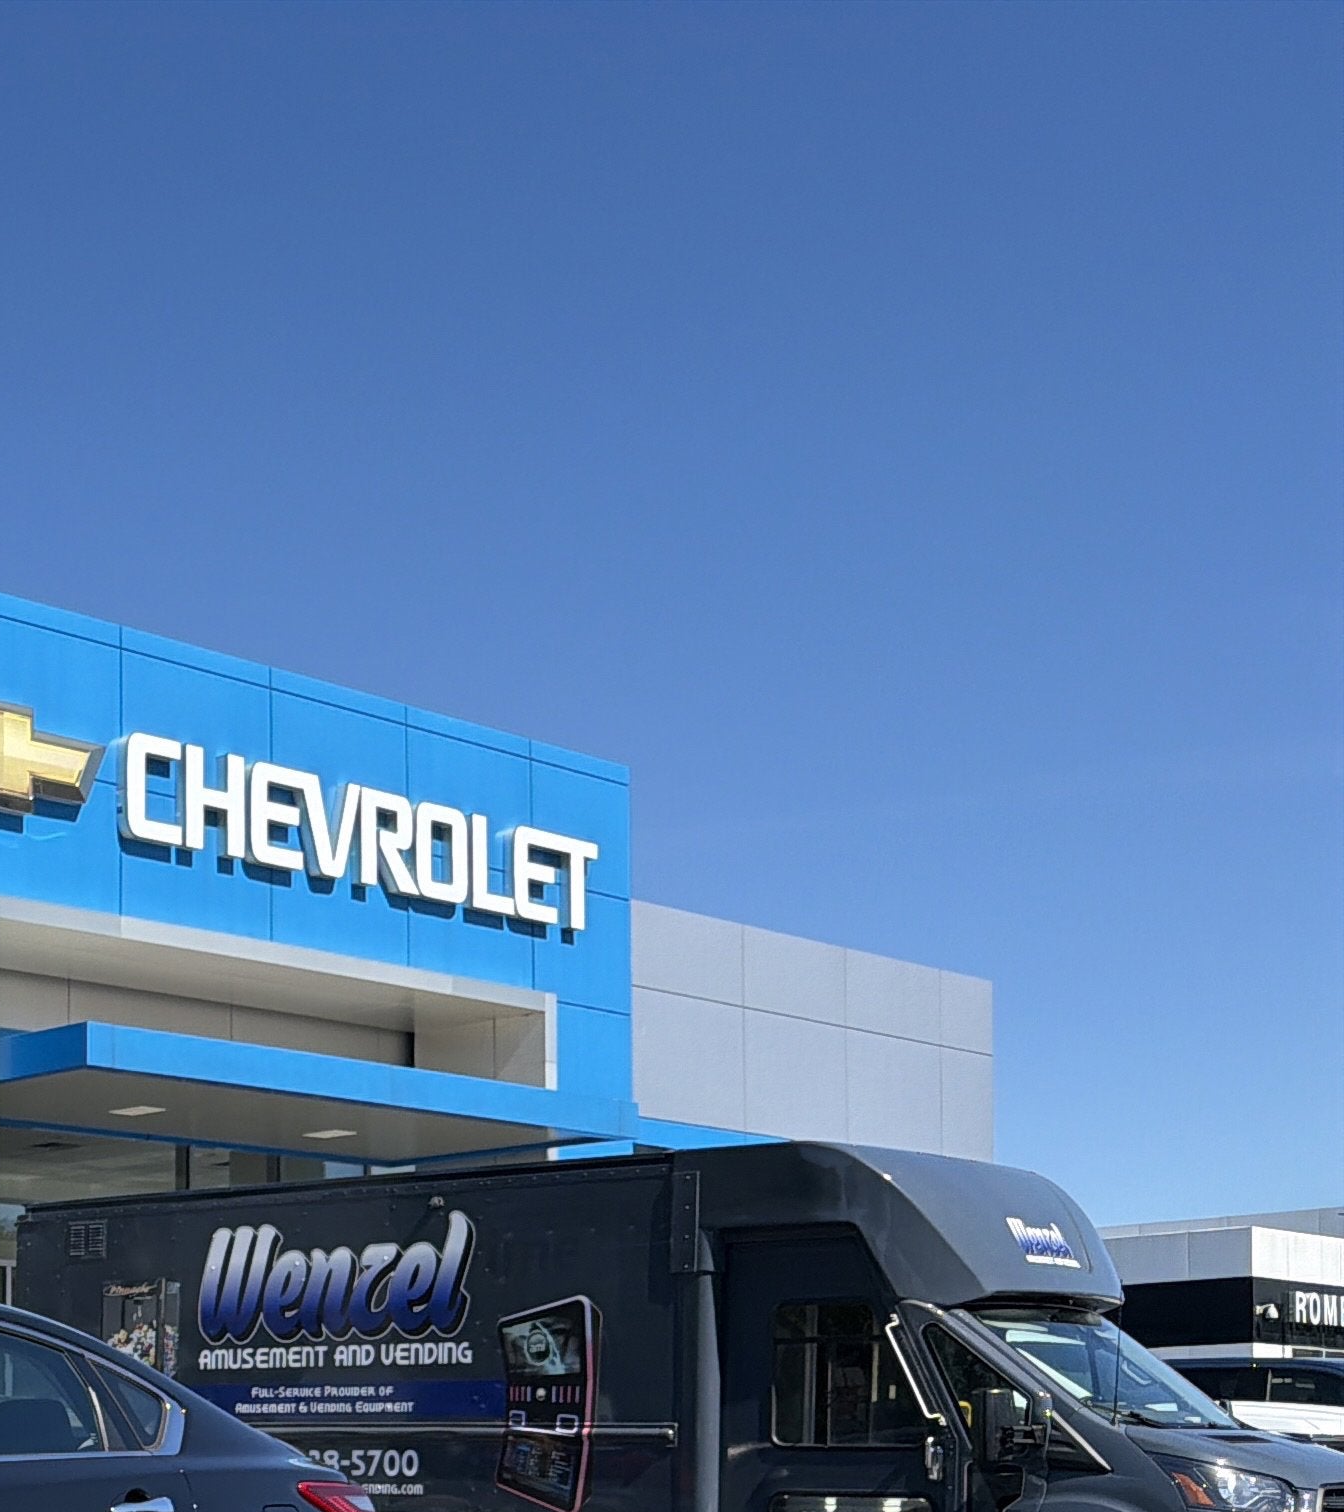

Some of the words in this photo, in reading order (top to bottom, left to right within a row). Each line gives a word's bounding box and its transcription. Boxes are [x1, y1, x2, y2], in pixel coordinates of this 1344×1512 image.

[121, 732, 599, 932] CHEVROLET
[198, 1210, 476, 1345] Wenzel
[198, 1345, 328, 1370] AMUSEMENT
[333, 1345, 375, 1367] AND
[380, 1341, 473, 1366] VENDING
